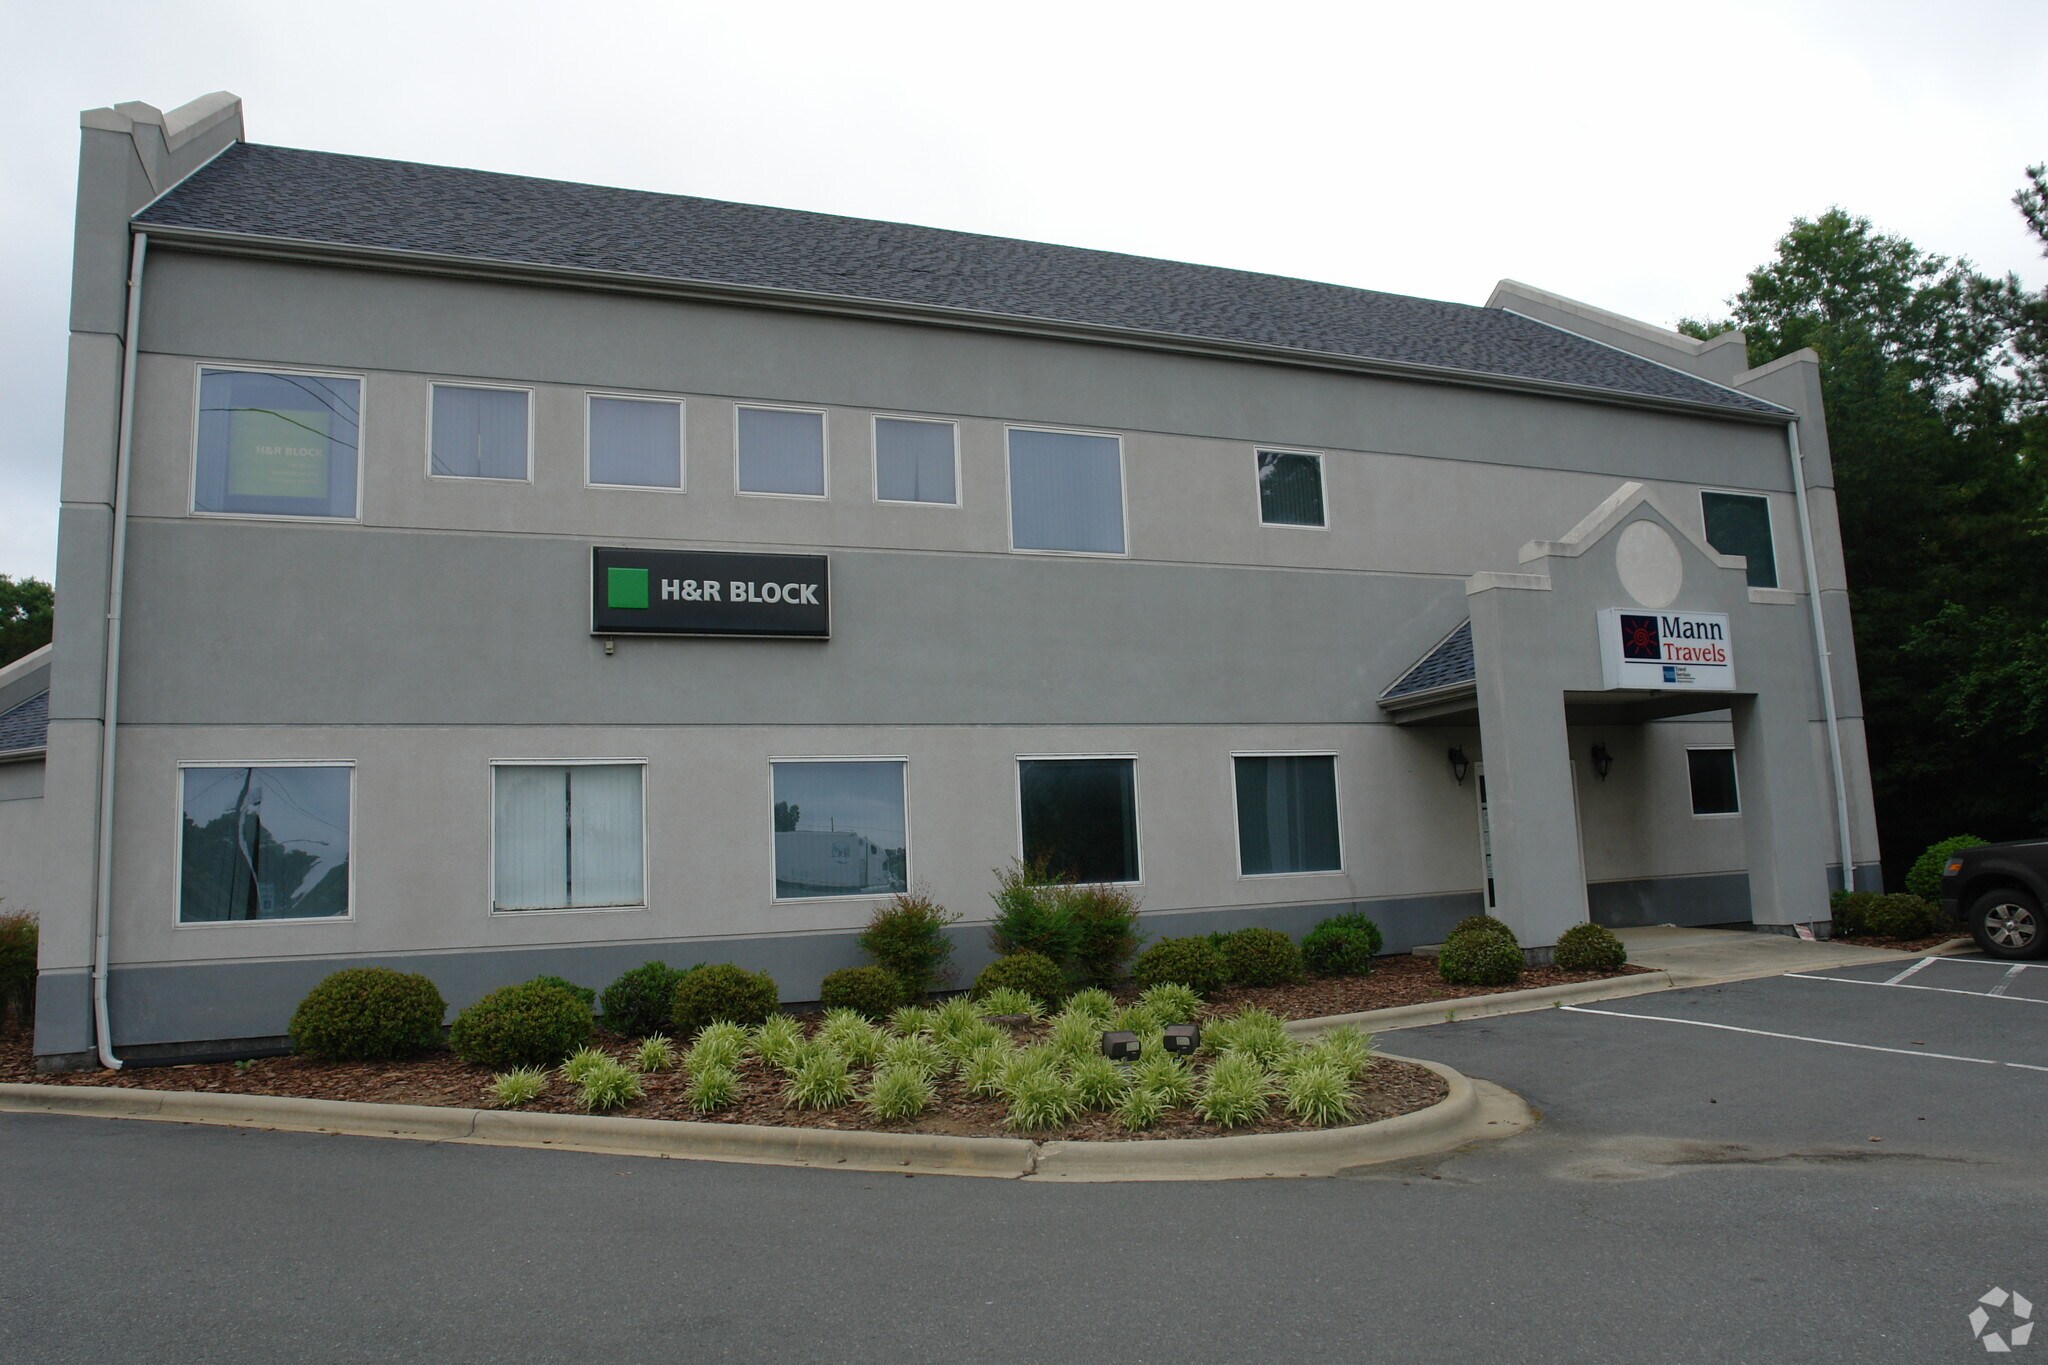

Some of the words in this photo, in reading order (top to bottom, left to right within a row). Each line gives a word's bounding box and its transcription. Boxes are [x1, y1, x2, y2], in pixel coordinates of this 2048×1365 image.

[285, 447, 323, 457] BLOCK
[661, 579, 721, 602] H&R
[730, 581, 819, 605] BLOCK
[1661, 616, 1723, 640] Mann
[1663, 643, 1726, 662] Travels
